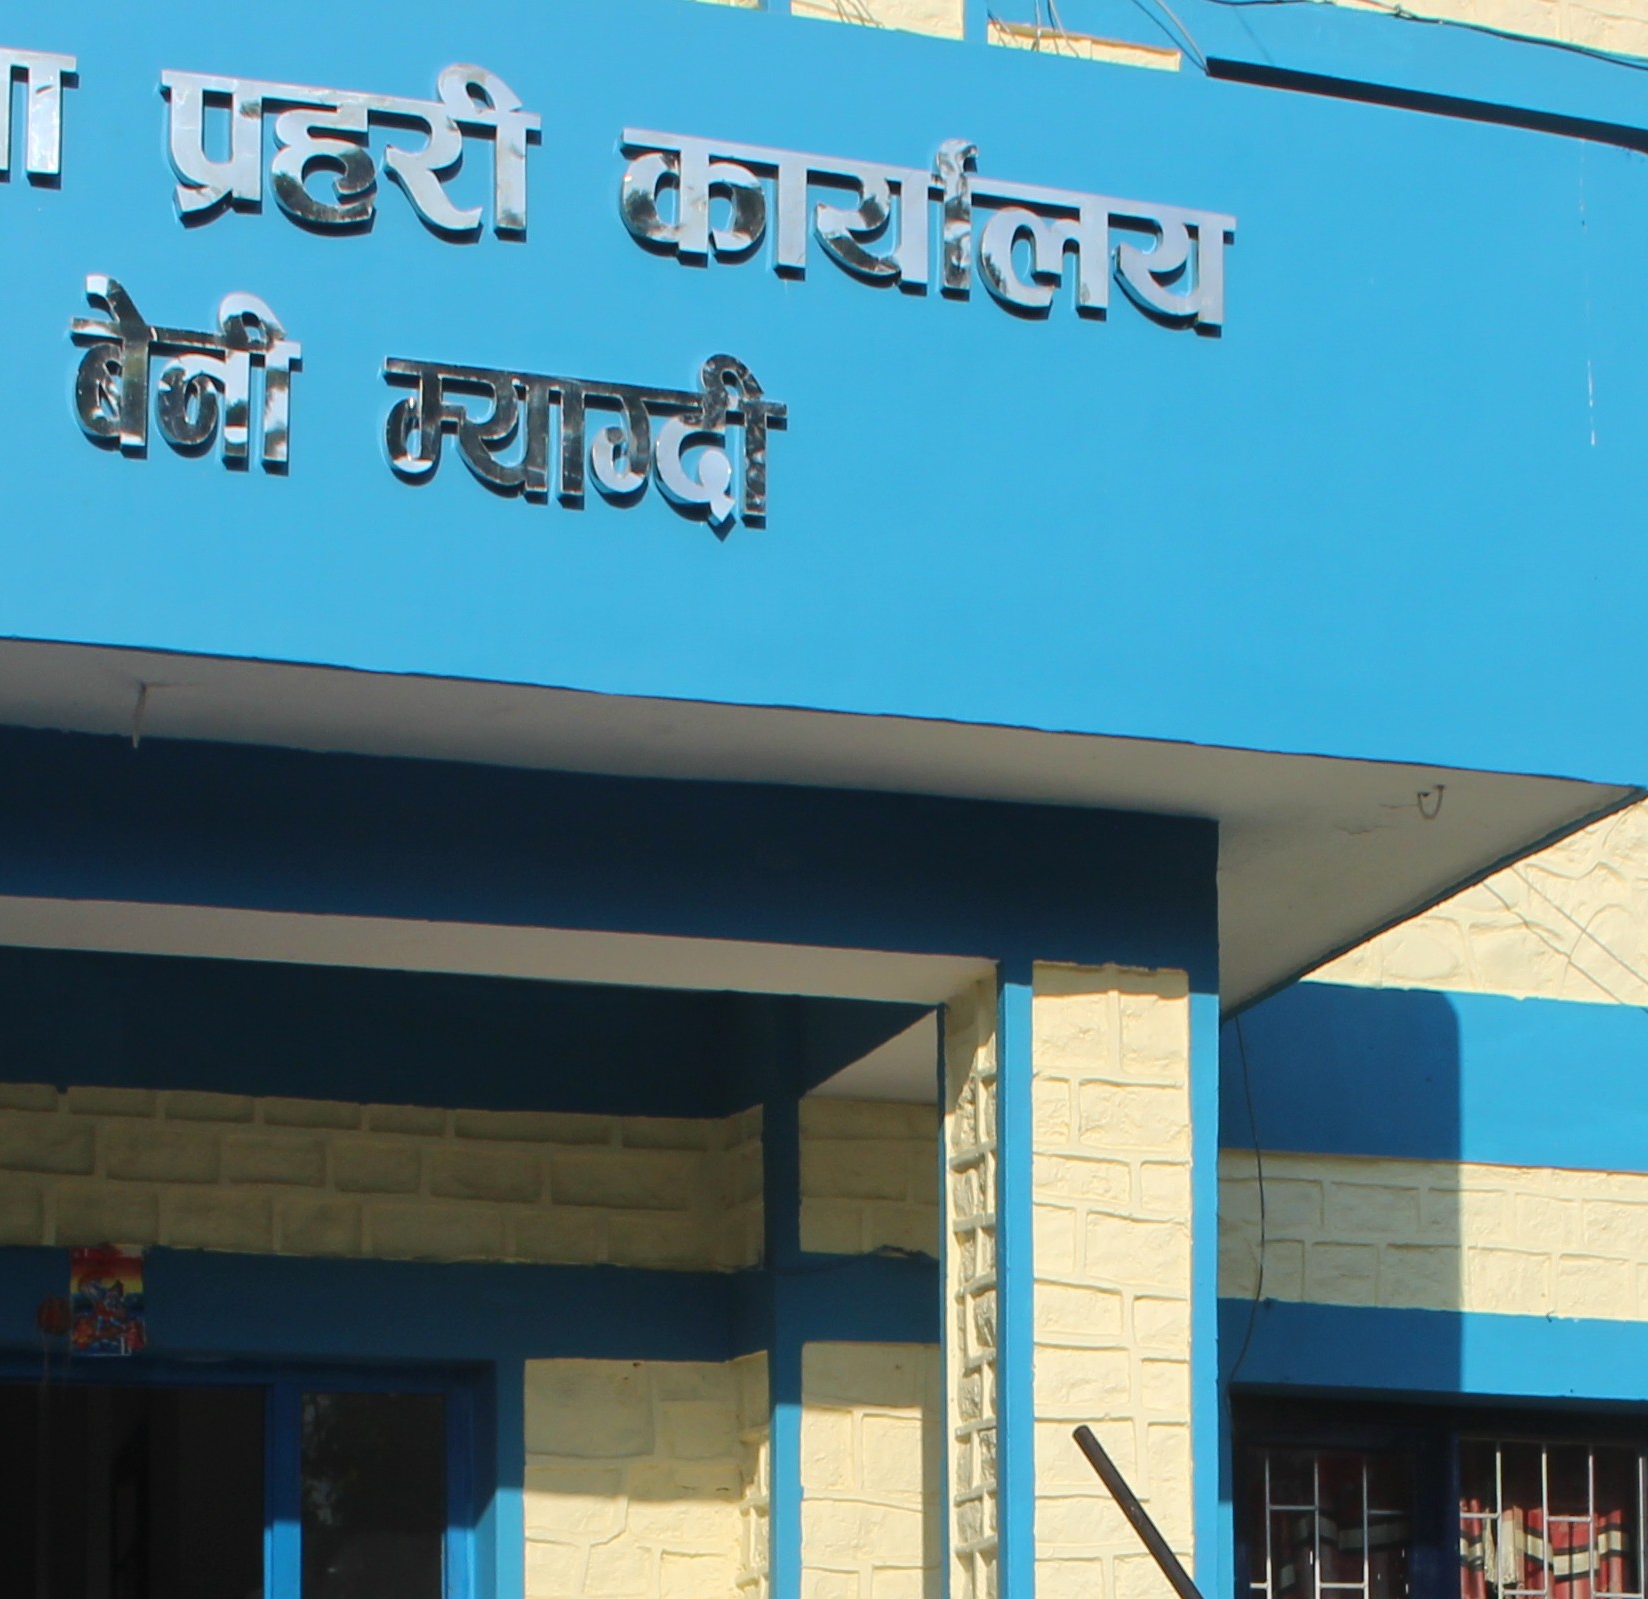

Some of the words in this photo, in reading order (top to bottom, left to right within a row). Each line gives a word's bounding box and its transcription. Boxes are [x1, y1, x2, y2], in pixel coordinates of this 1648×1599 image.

[162, 64, 541, 238] प्रहरी
[619, 127, 1238, 332] कार्यालय
[70, 275, 302, 470] बेनी
[382, 353, 788, 530] म्याग्दी
